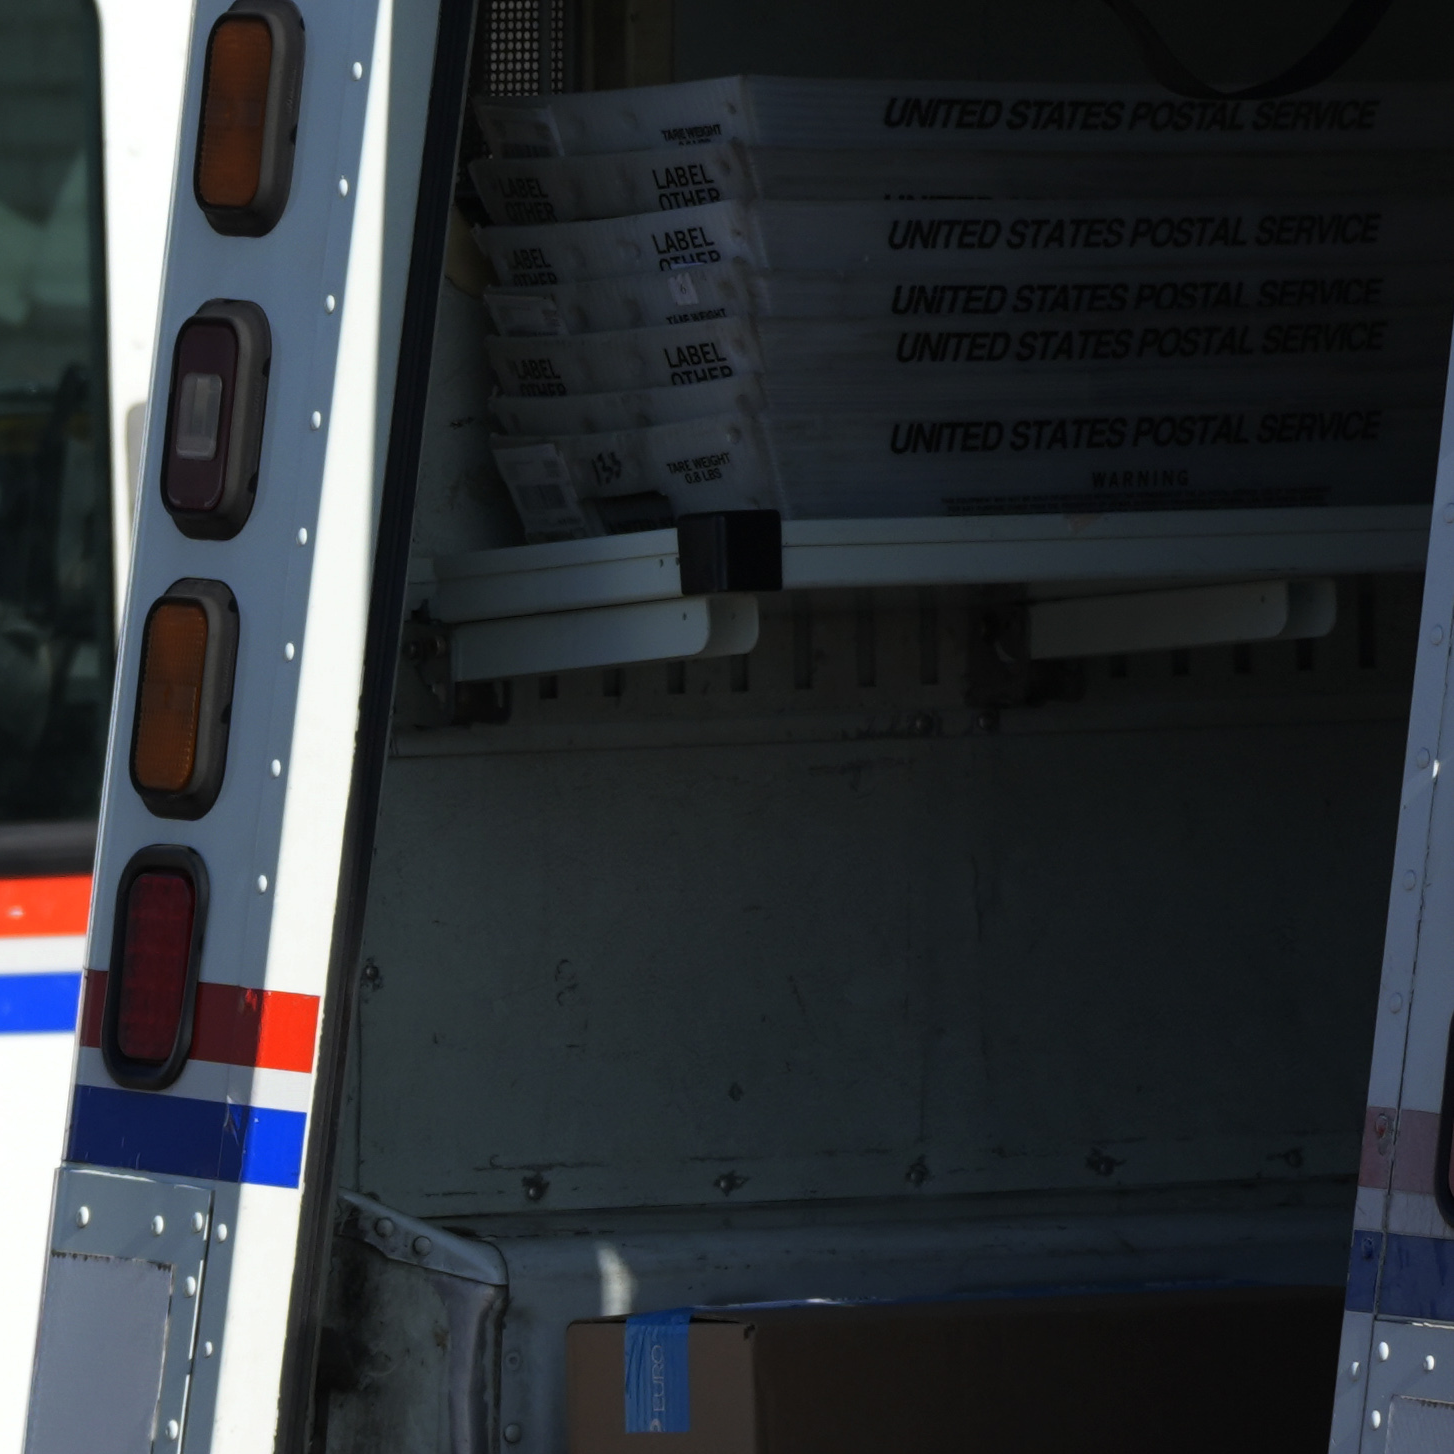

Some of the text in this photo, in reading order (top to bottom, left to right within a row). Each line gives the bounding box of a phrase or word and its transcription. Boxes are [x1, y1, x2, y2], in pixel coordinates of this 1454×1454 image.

[884, 98, 1378, 131] UNITED STATES POSTAL SERVICE
[660, 123, 722, 142] TARE WEIGHT
[497, 177, 549, 199] LABEL
[652, 164, 714, 189] LABEL
[658, 187, 720, 211] OTHER
[505, 201, 558, 222] OTHER
[652, 226, 714, 255] LABEL
[888, 213, 1381, 249] UNITED STATES POSTAL SERVICE
[892, 278, 1383, 315] UNITED STATES POSTAL SERVICE
[897, 321, 1388, 362] UNITED STATES POSTAL SERVICE
[664, 342, 727, 369] LABEL
[514, 358, 561, 380] LABEL
[891, 411, 1382, 454] UNITED STATES POSTAL SERVICE
[666, 451, 731, 475] TARE WEIGHT
[684, 468, 724, 485] 0.8 LBS
[1092, 470, 1191, 489] WARNING
